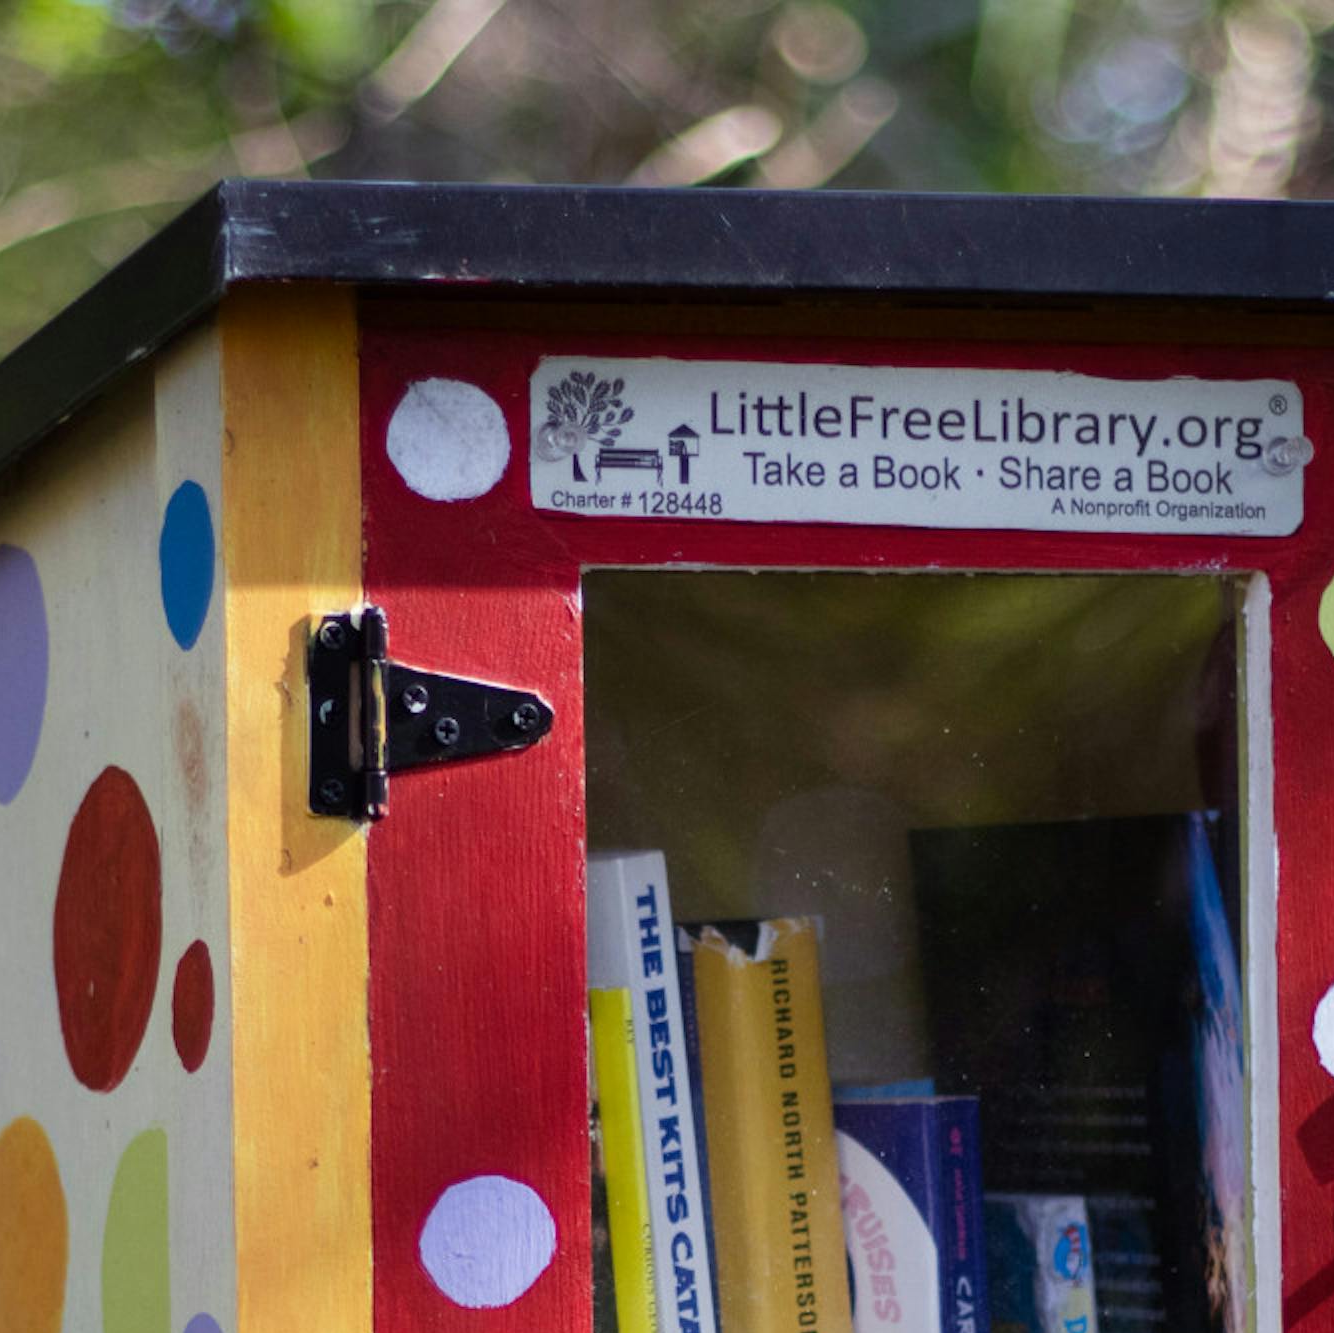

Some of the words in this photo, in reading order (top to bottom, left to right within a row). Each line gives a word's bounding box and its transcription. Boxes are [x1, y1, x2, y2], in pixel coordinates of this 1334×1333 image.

[710, 391, 1264, 460] LittleFreeLibrary.org
[743, 452, 826, 488] Take
[839, 463, 859, 489] a
[873, 455, 962, 491] Book
[998, 455, 1102, 493] Share
[1113, 468, 1134, 493] a
[1147, 460, 1234, 495] Book
[551, 490, 616, 509] Charter
[638, 490, 723, 516] 128448
[1051, 498, 1066, 516] A
[1070, 497, 1151, 520] Nonprofit
[1156, 499, 1266, 522] Organization
[634, 884, 663, 978] THE
[645, 987, 678, 1106] BEST
[771, 958, 794, 1079] RICHARD
[659, 1116, 690, 1225] KITS
[781, 1082, 807, 1184] NORTH
[840, 1173, 903, 1324] RUISES
